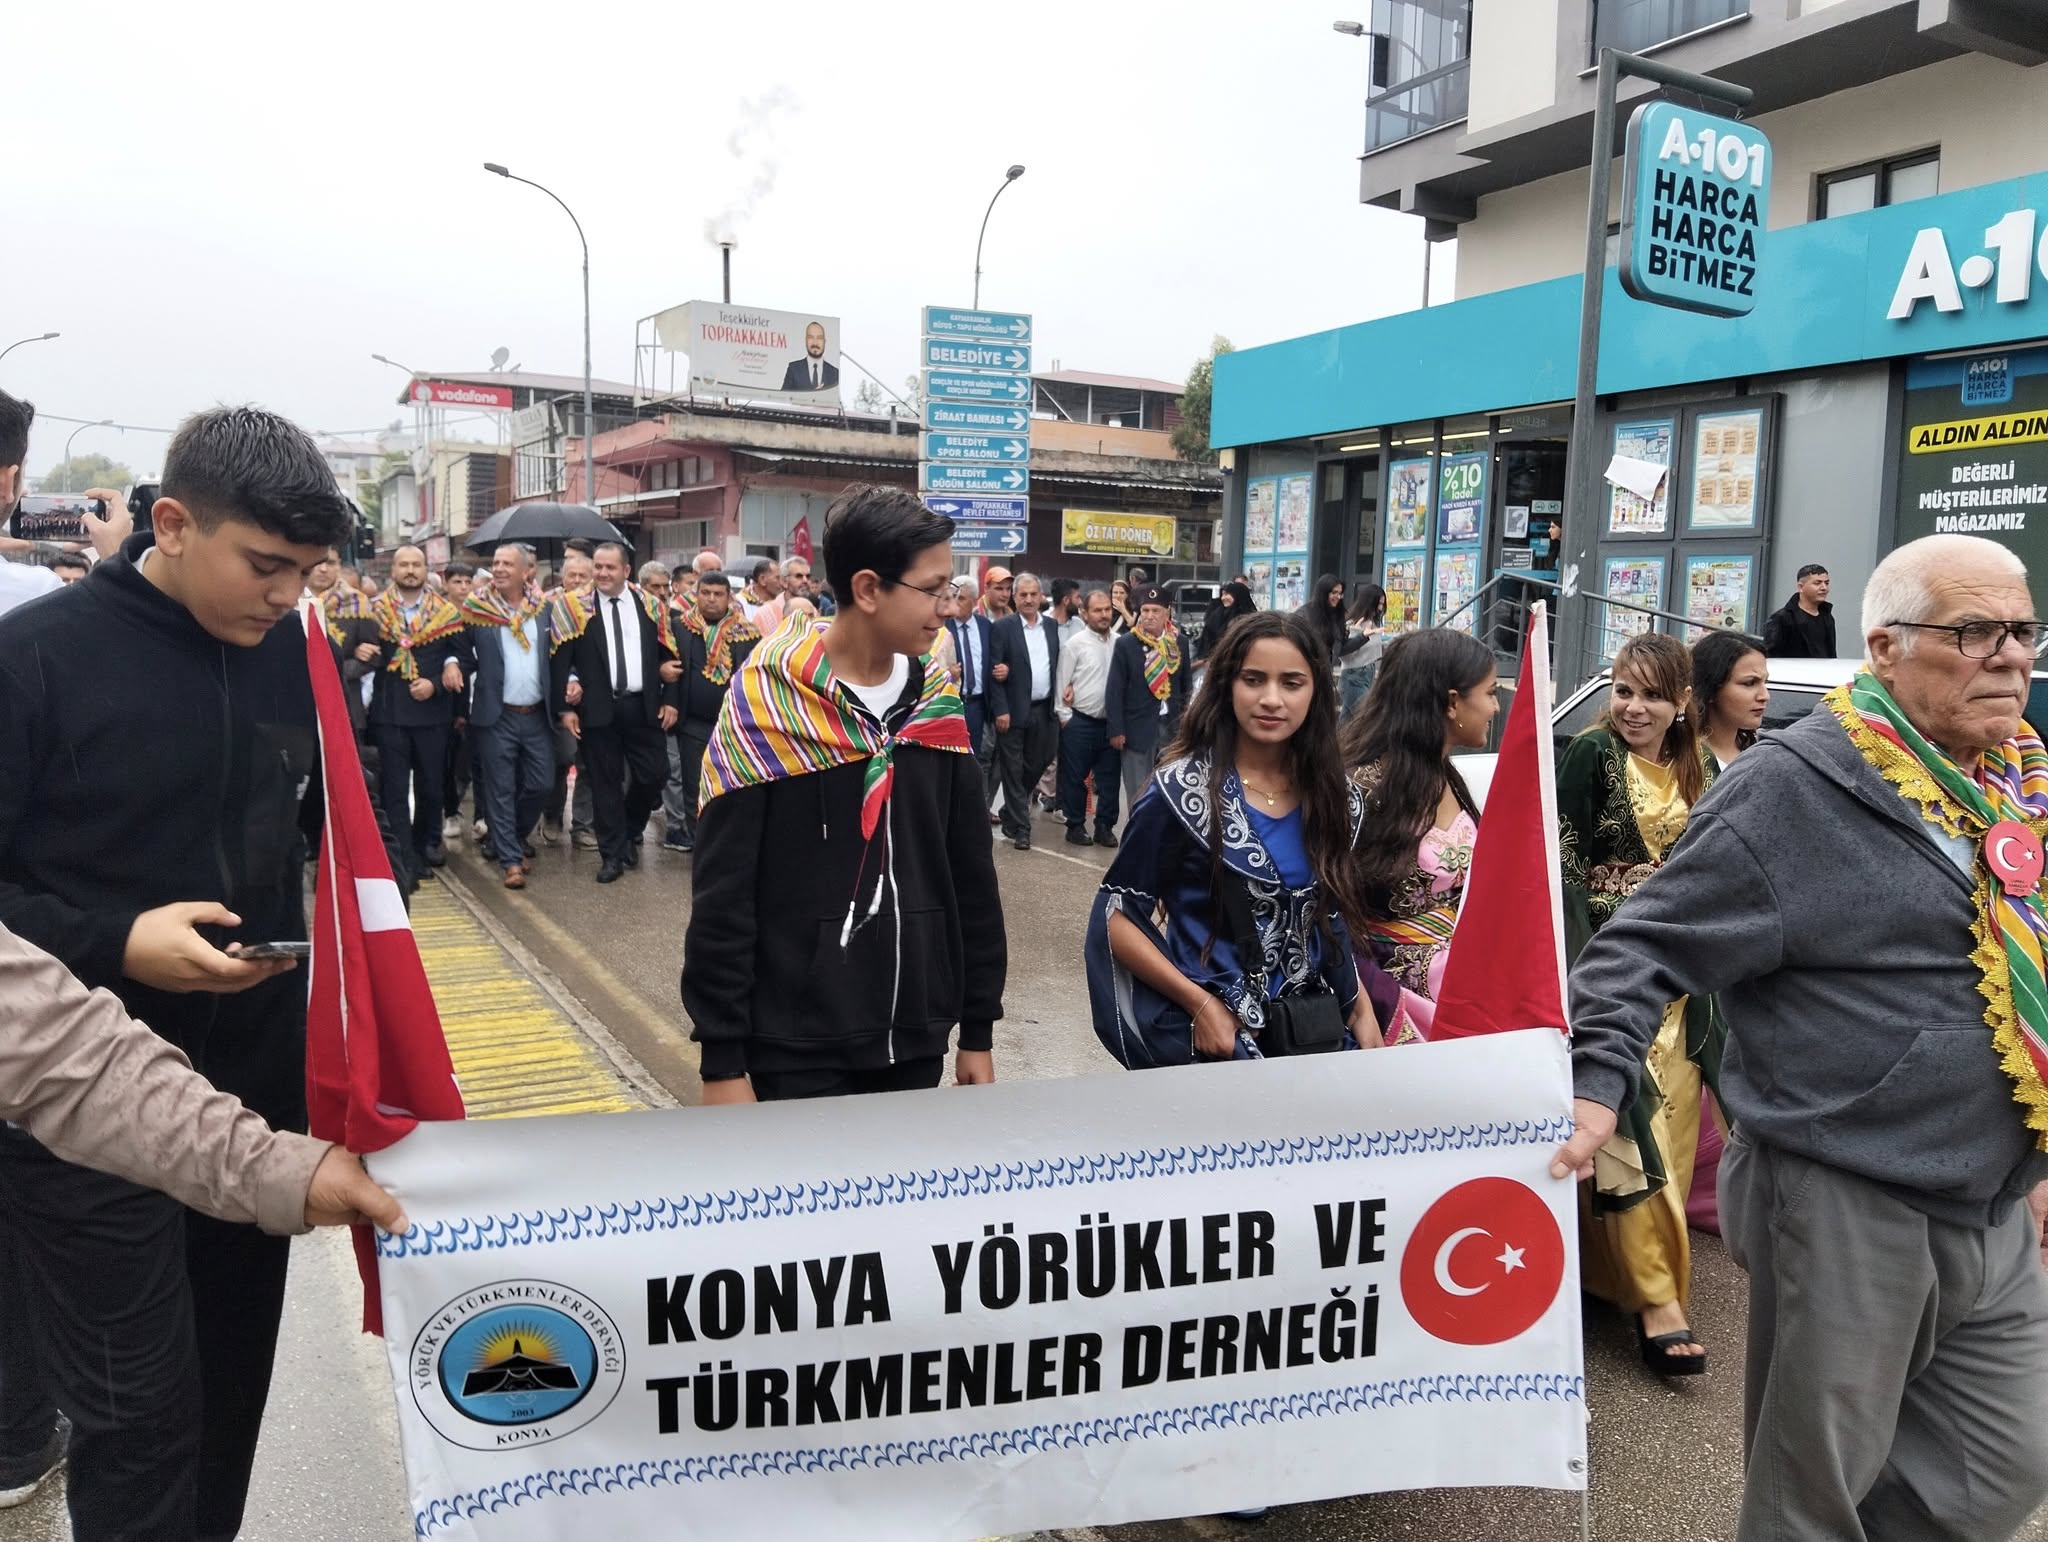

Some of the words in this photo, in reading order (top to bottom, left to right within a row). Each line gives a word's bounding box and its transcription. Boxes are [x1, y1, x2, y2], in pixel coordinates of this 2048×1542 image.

[1654, 168, 1759, 227] HARCA
[1651, 205, 1756, 262] HARCA
[719, 311, 771, 328] Teşekkürler
[702, 324, 788, 349] TOPRAKKALEM
[930, 347, 1002, 365] BELEDİYE
[1968, 370, 2008, 382] HARCA
[1968, 380, 2007, 391] HARCA
[437, 389, 498, 405] vodafone
[934, 409, 965, 422] ZİRAAT
[967, 412, 1005, 425] BANKASI
[946, 437, 989, 447] BELEDİYE
[1917, 424, 1980, 448] ALDIN
[937, 447, 961, 457] SPOR
[963, 449, 1000, 459] SALONU
[946, 468, 987, 478] BELEDİYE
[1444, 463, 1482, 491] %10
[1952, 460, 2015, 483] DEĞERLİ
[966, 480, 1001, 490] SALONU
[972, 501, 1013, 510] TOPRAKKALE
[1919, 484, 2047, 511] MÜŞTERİLERİMİZ
[962, 508, 985, 517] DEVLET
[986, 508, 1021, 517] HASTANESİ
[1936, 512, 2025, 532] MAĞAZAMIZ
[1085, 520, 1099, 539] ÖZ
[1102, 526, 1119, 540] TAT
[1120, 523, 1153, 543] DÖNER
[648, 1253, 891, 1346] KONYA
[931, 1210, 1275, 1315] YÖRÜKLER
[1314, 1198, 1386, 1269] VE
[416, 1334, 440, 1390] YÖRÜK
[434, 1316, 457, 1333] VE
[454, 1286, 585, 1316] TÜRKMENLER
[582, 1310, 620, 1373] DERNEĞİ
[645, 1332, 1103, 1434] TÜRKMENLER
[1121, 1284, 1380, 1389] DERNEĞİ
[496, 1427, 551, 1446] KONYA
